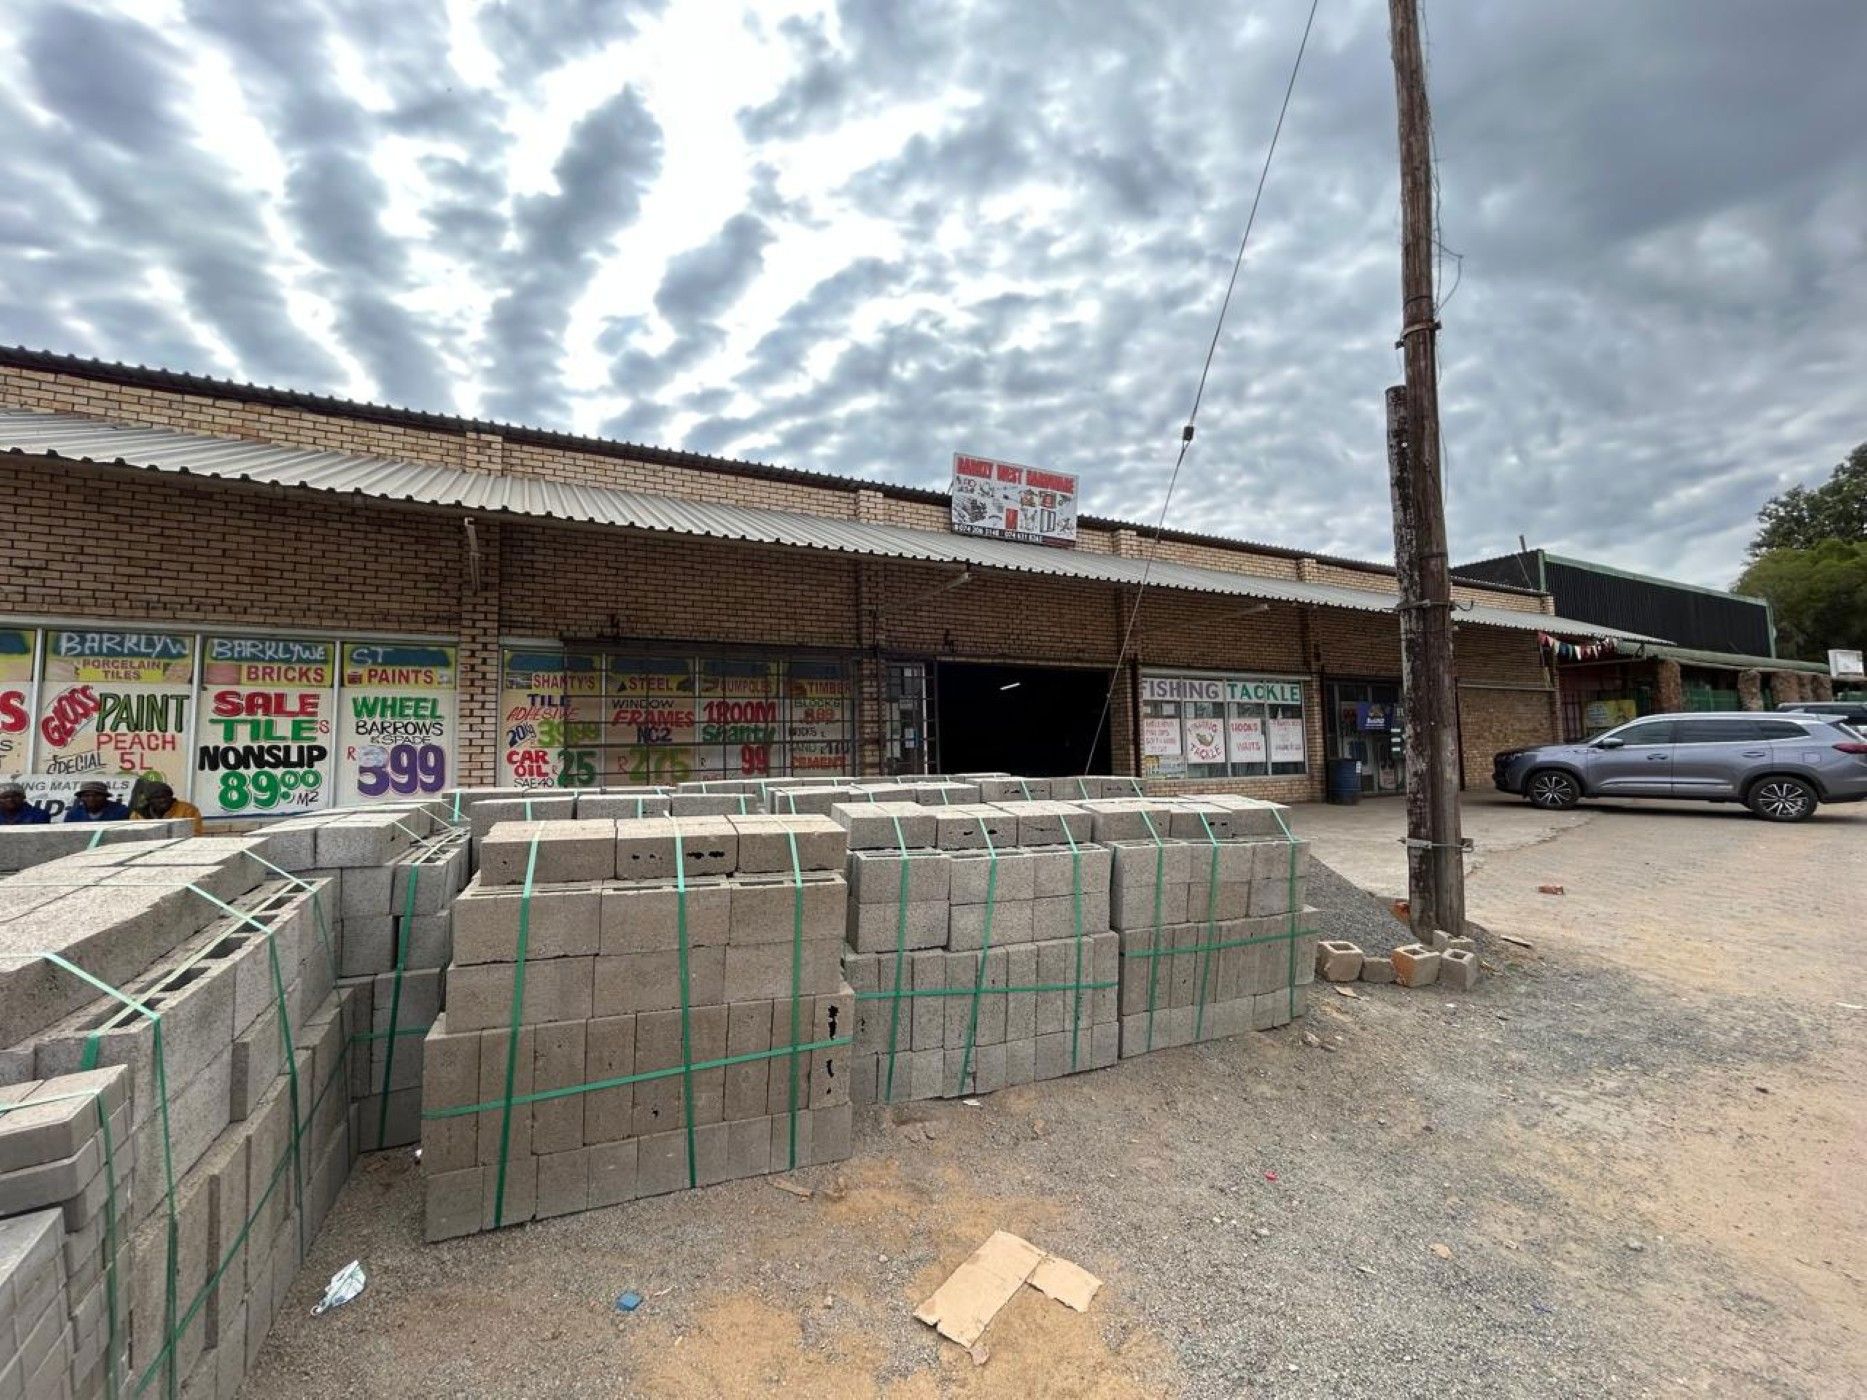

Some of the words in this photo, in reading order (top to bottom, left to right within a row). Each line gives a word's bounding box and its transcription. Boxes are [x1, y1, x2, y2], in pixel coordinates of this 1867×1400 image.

[103, 670, 142, 681] TILES
[246, 665, 325, 683] BRICKS
[368, 669, 434, 686] PAINTS
[533, 674, 597, 690] SHANTY'S
[629, 676, 674, 691] STEEL
[1141, 680, 1219, 700] FISHING
[1227, 685, 1301, 702] TACKLE
[213, 690, 321, 718] SALE
[352, 697, 445, 720] WHEEL
[612, 699, 674, 710] WINDOW
[96, 693, 191, 733] PAINT
[612, 709, 695, 728] FRAMES
[355, 720, 444, 737] BARROWS
[97, 733, 176, 751] PEACH
[198, 745, 328, 771] NONSLIP
[507, 750, 550, 766] CAR
[514, 764, 549, 778] OIL
